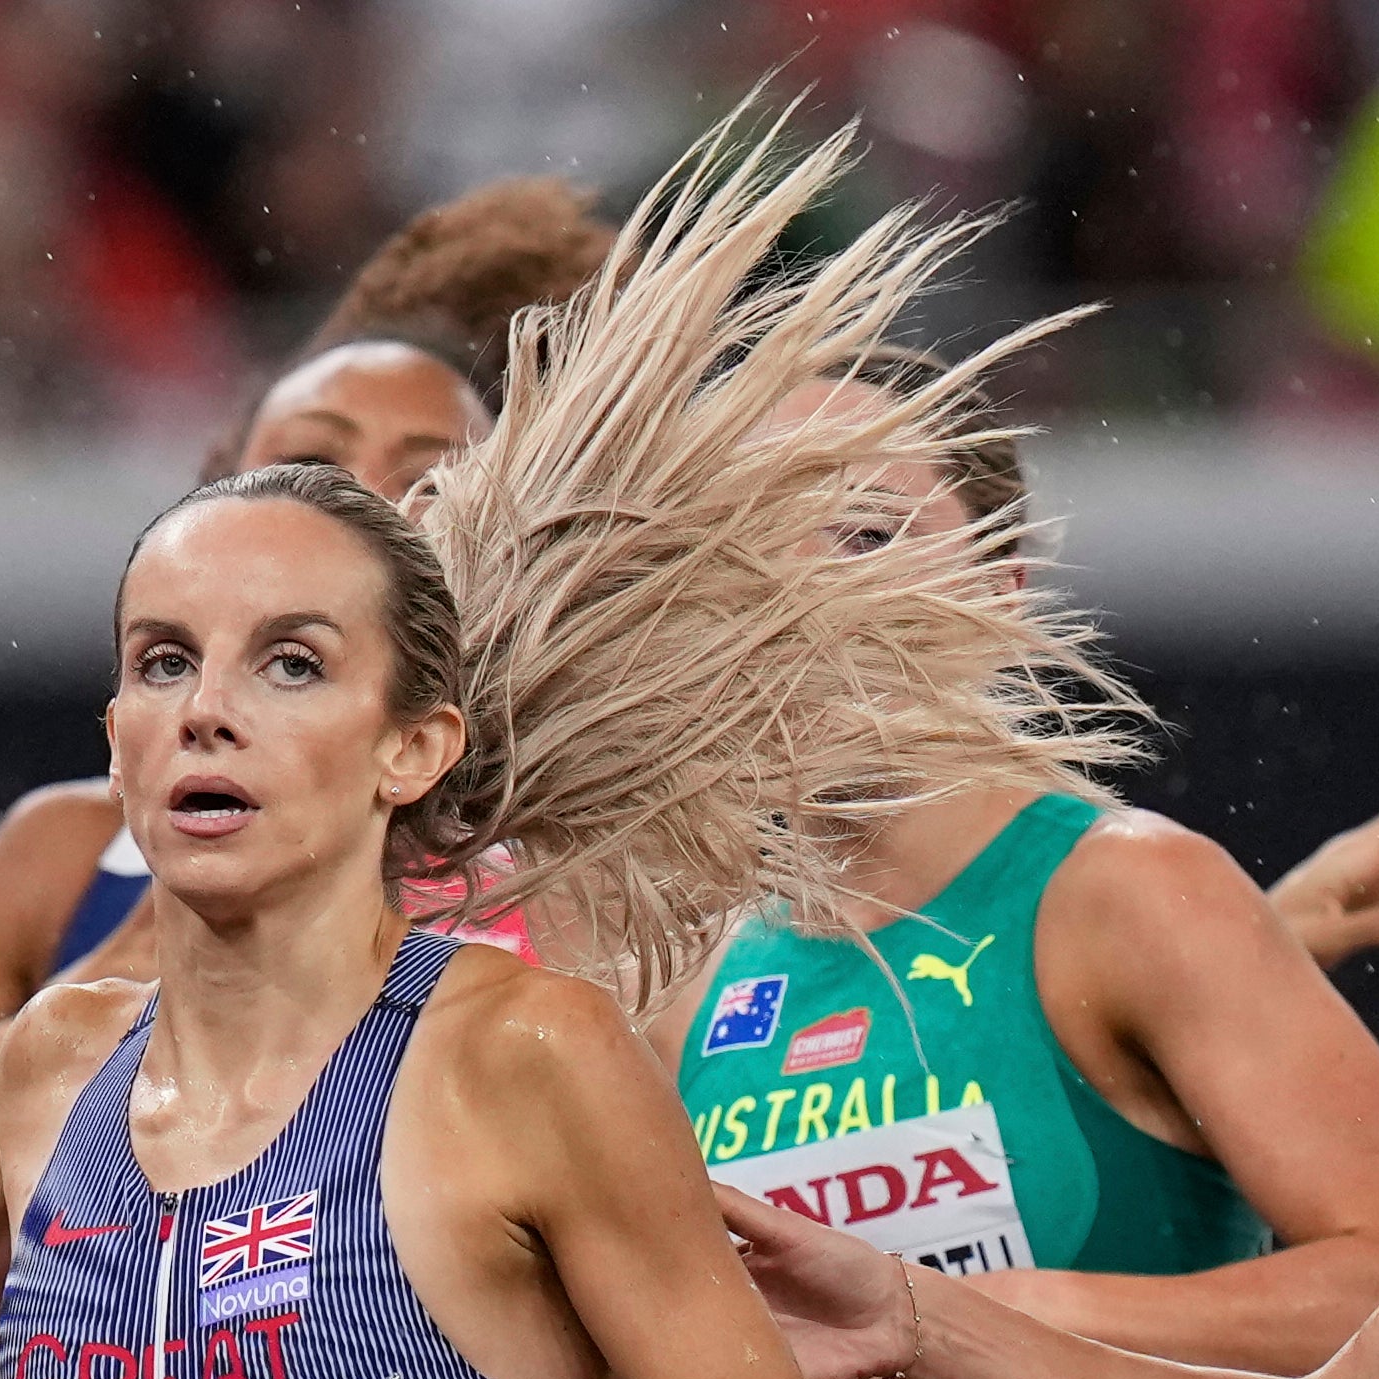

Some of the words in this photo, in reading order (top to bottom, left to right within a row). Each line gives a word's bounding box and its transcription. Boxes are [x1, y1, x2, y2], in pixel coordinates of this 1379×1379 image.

[694, 1073, 985, 1163] USTRALI
[763, 1147, 1000, 1228] NDA
[202, 1275, 309, 1324] Novuna
